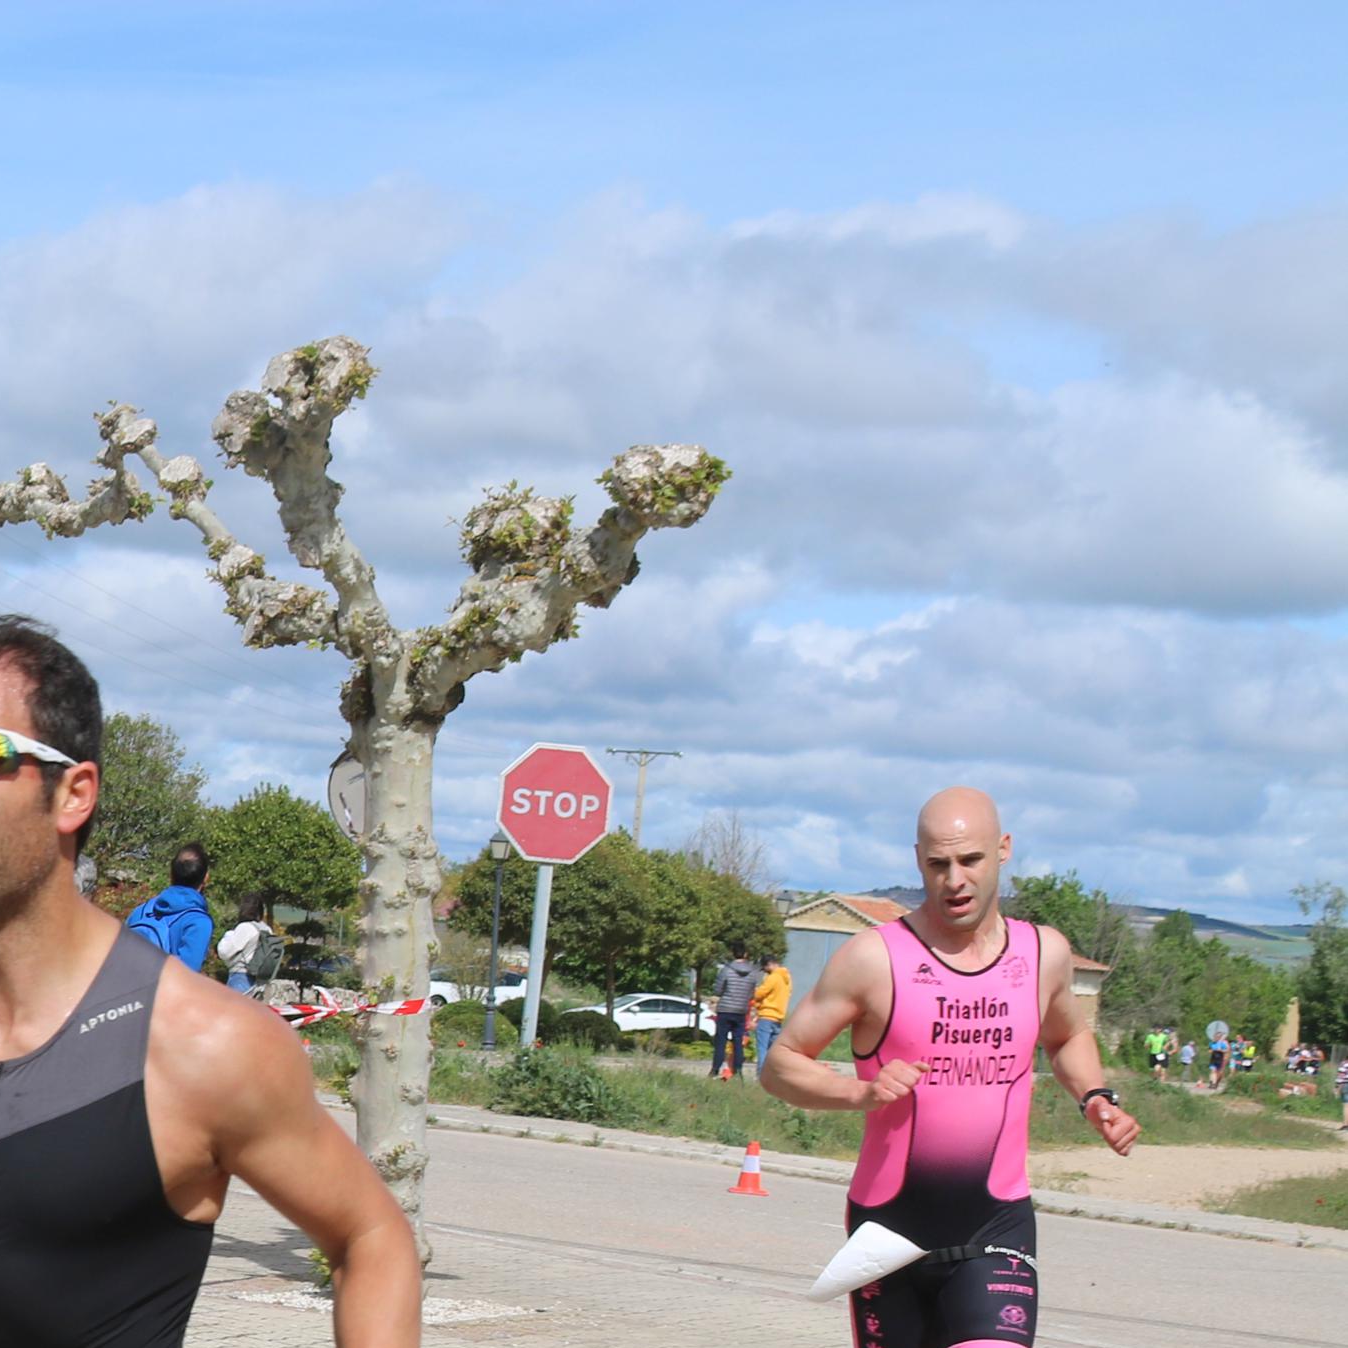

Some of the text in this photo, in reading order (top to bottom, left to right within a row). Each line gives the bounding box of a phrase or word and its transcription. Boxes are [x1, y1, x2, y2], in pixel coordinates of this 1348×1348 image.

[510, 787, 600, 820] STOP
[79, 1000, 144, 1034] APTONIA
[935, 996, 1009, 1020] Triatlón
[930, 1021, 1014, 1050] Pisuerga
